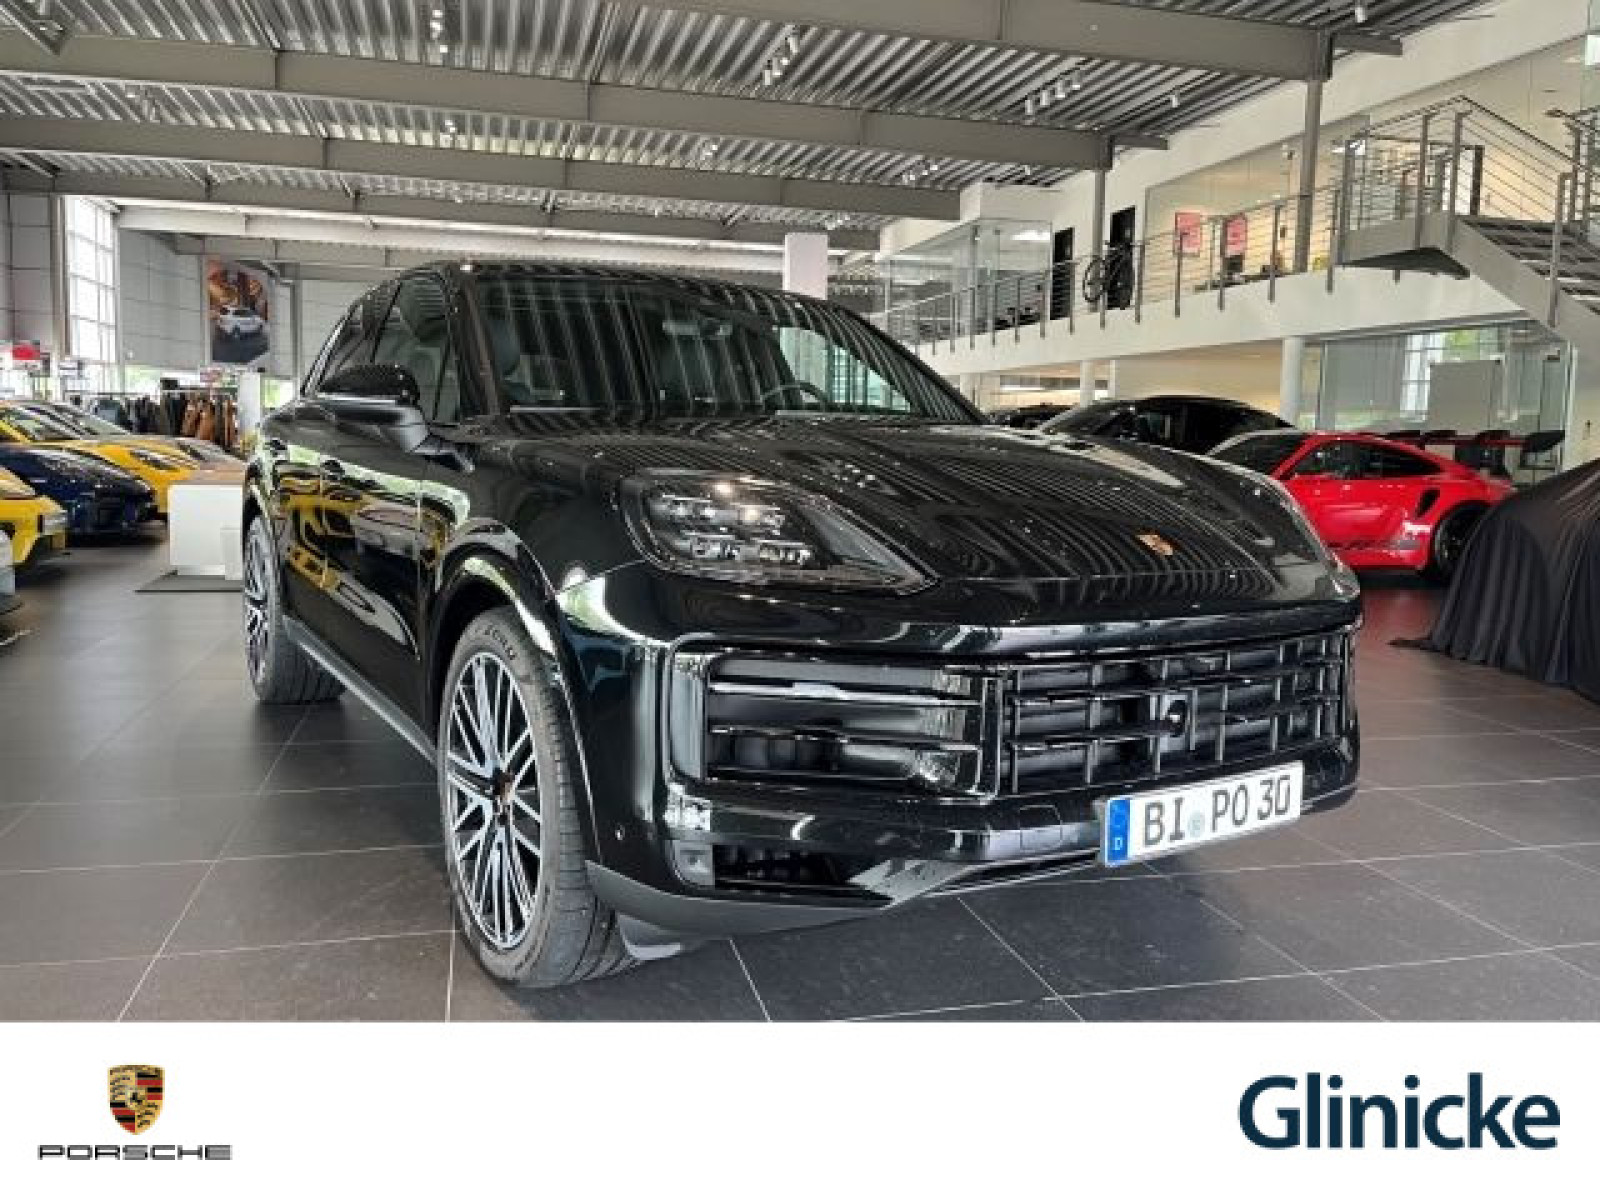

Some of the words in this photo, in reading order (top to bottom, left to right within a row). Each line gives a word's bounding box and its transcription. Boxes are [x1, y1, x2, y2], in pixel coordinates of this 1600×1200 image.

[1143, 797, 1186, 848] BI
[1211, 784, 1250, 833] PO
[1257, 774, 1291, 821] 30
